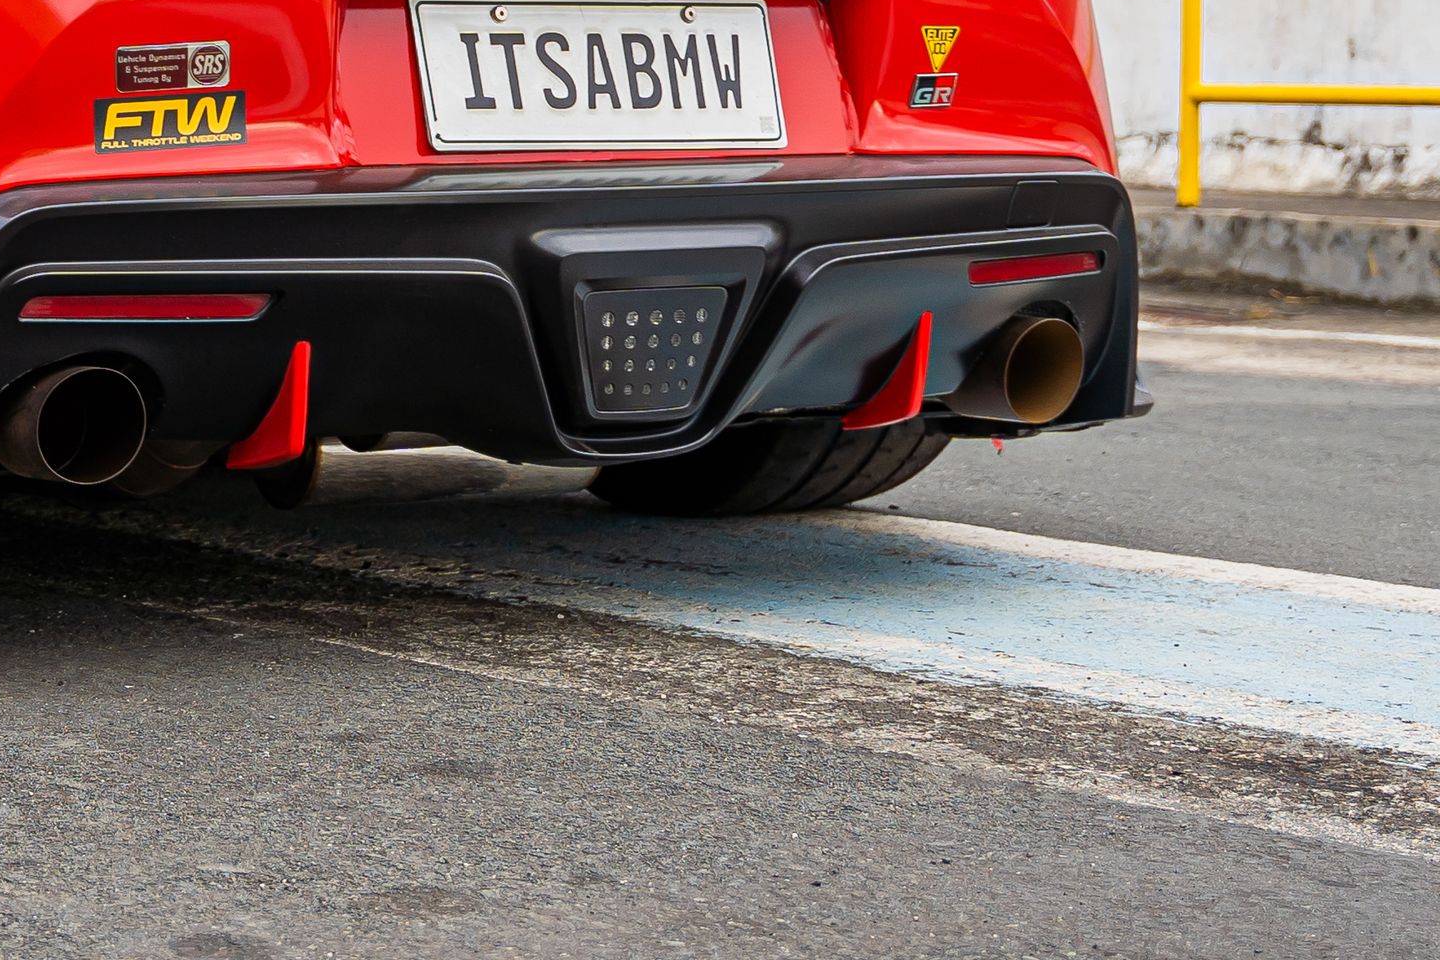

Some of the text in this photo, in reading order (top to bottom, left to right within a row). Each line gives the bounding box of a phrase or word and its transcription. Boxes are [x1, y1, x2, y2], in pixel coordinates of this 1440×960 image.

[926, 28, 955, 41] ELITE
[117, 52, 187, 64] Vehicle Dynamics
[192, 53, 226, 76] SRS
[125, 64, 180, 74] & Suspension
[459, 32, 743, 111] ITSABMW
[132, 74, 172, 84] Tuning By
[913, 86, 953, 104] GR
[103, 95, 237, 140] FTW
[101, 132, 242, 150] FULL THROTTLE WEEKEND
